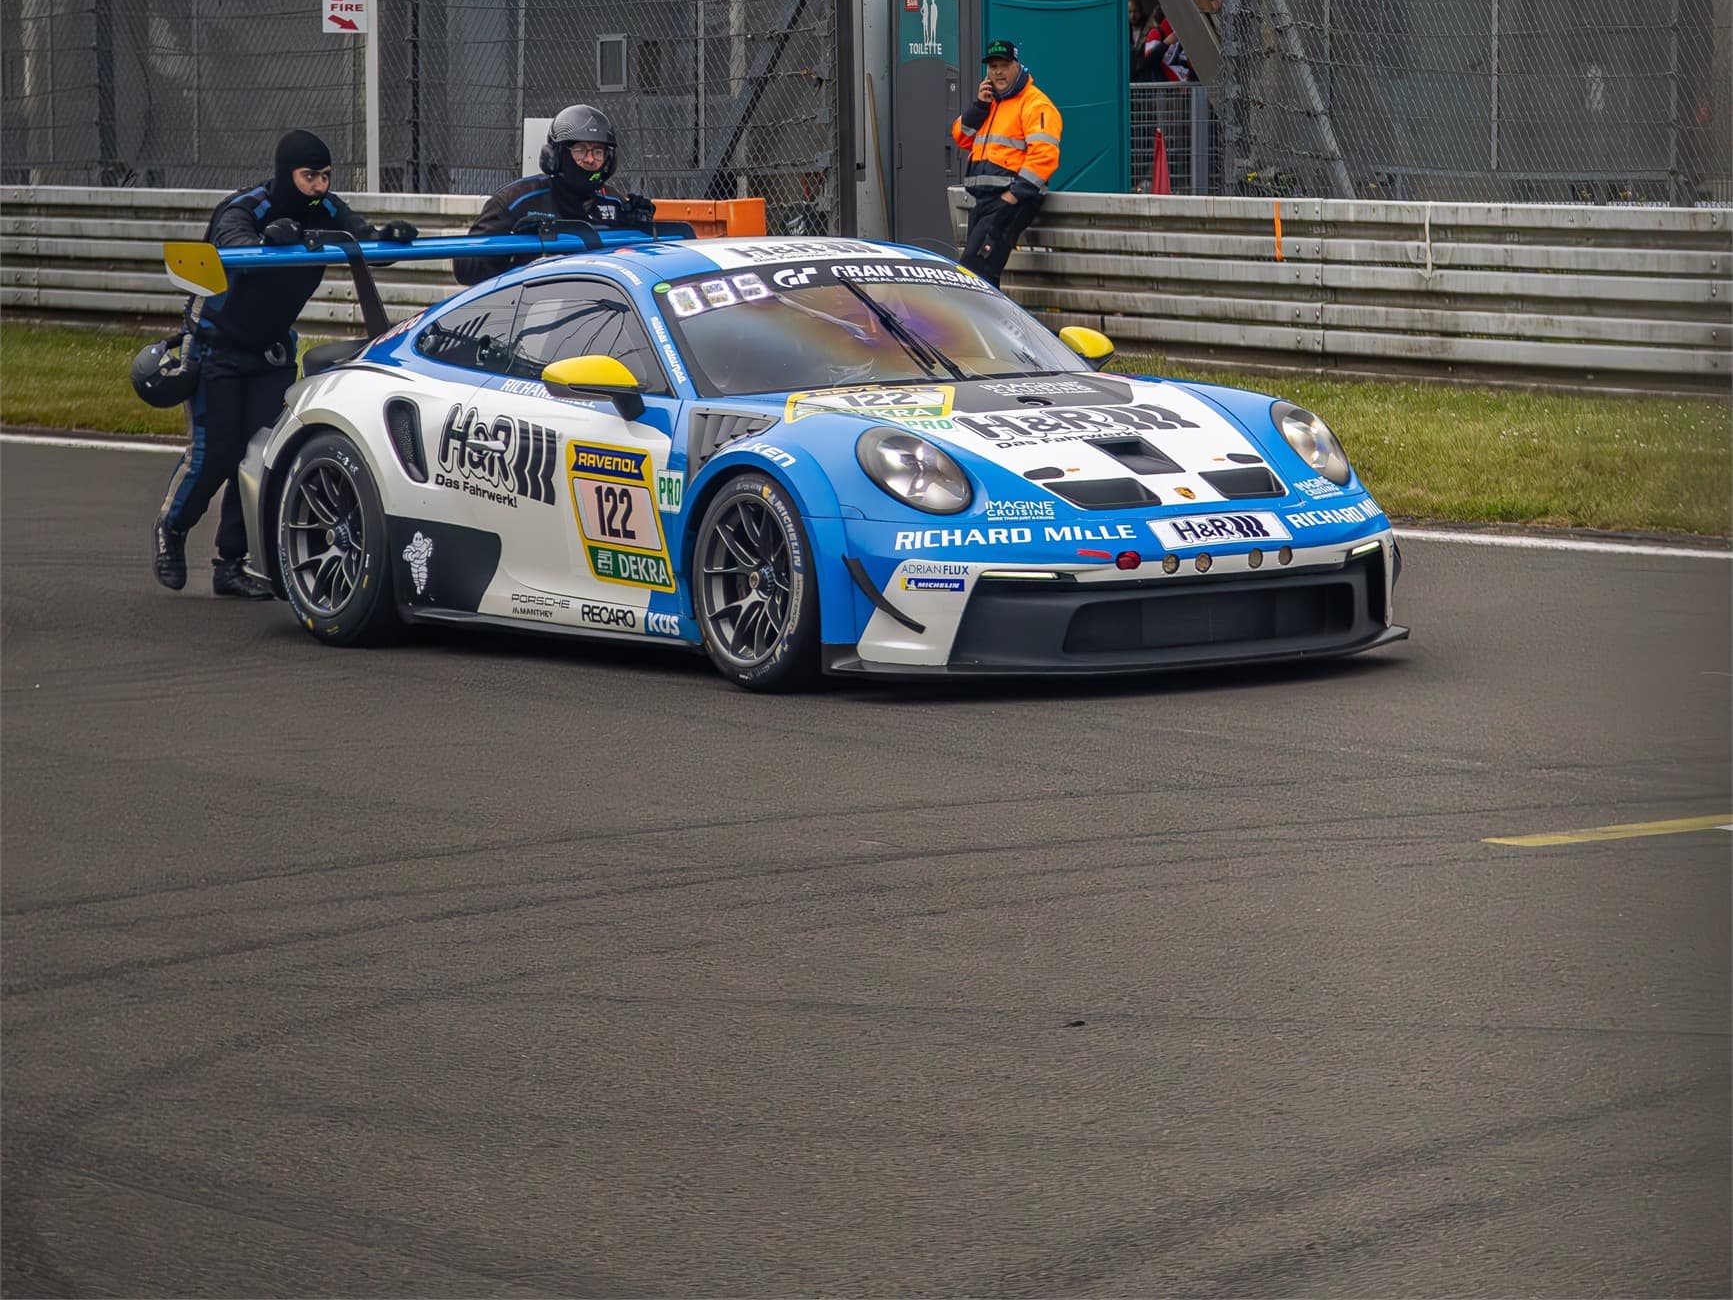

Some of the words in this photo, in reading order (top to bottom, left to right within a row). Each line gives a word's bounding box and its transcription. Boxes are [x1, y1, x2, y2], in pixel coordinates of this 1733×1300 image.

[330, 3, 365, 12] FIRE
[908, 43, 943, 56] TOILETTE
[830, 265, 892, 279] GRAN
[894, 265, 989, 290] TURISMO
[840, 391, 918, 407] 122
[904, 419, 953, 430] PRO
[953, 409, 1121, 441] H&R
[438, 402, 516, 494] H&R
[996, 438, 1037, 449] Das
[577, 452, 640, 475] RAVENOL
[434, 473, 461, 491] Das
[462, 482, 518, 509] Fahrwerk!
[658, 476, 682, 507] PRO
[595, 485, 636, 540] 122
[985, 500, 1055, 510] IMAGINE
[986, 509, 1055, 517] CRUISING
[1286, 505, 1367, 529] RICHARD
[1357, 497, 1384, 519] MIL
[774, 500, 803, 567] MICHELIN
[895, 527, 1033, 551] RICHARD
[1045, 524, 1138, 543] MILLE
[1168, 517, 1239, 544] H&R
[618, 553, 671, 585] DEKRA
[511, 593, 571, 609] PORSCHE
[581, 603, 636, 629] RECARO
[648, 611, 681, 637] KÜS
